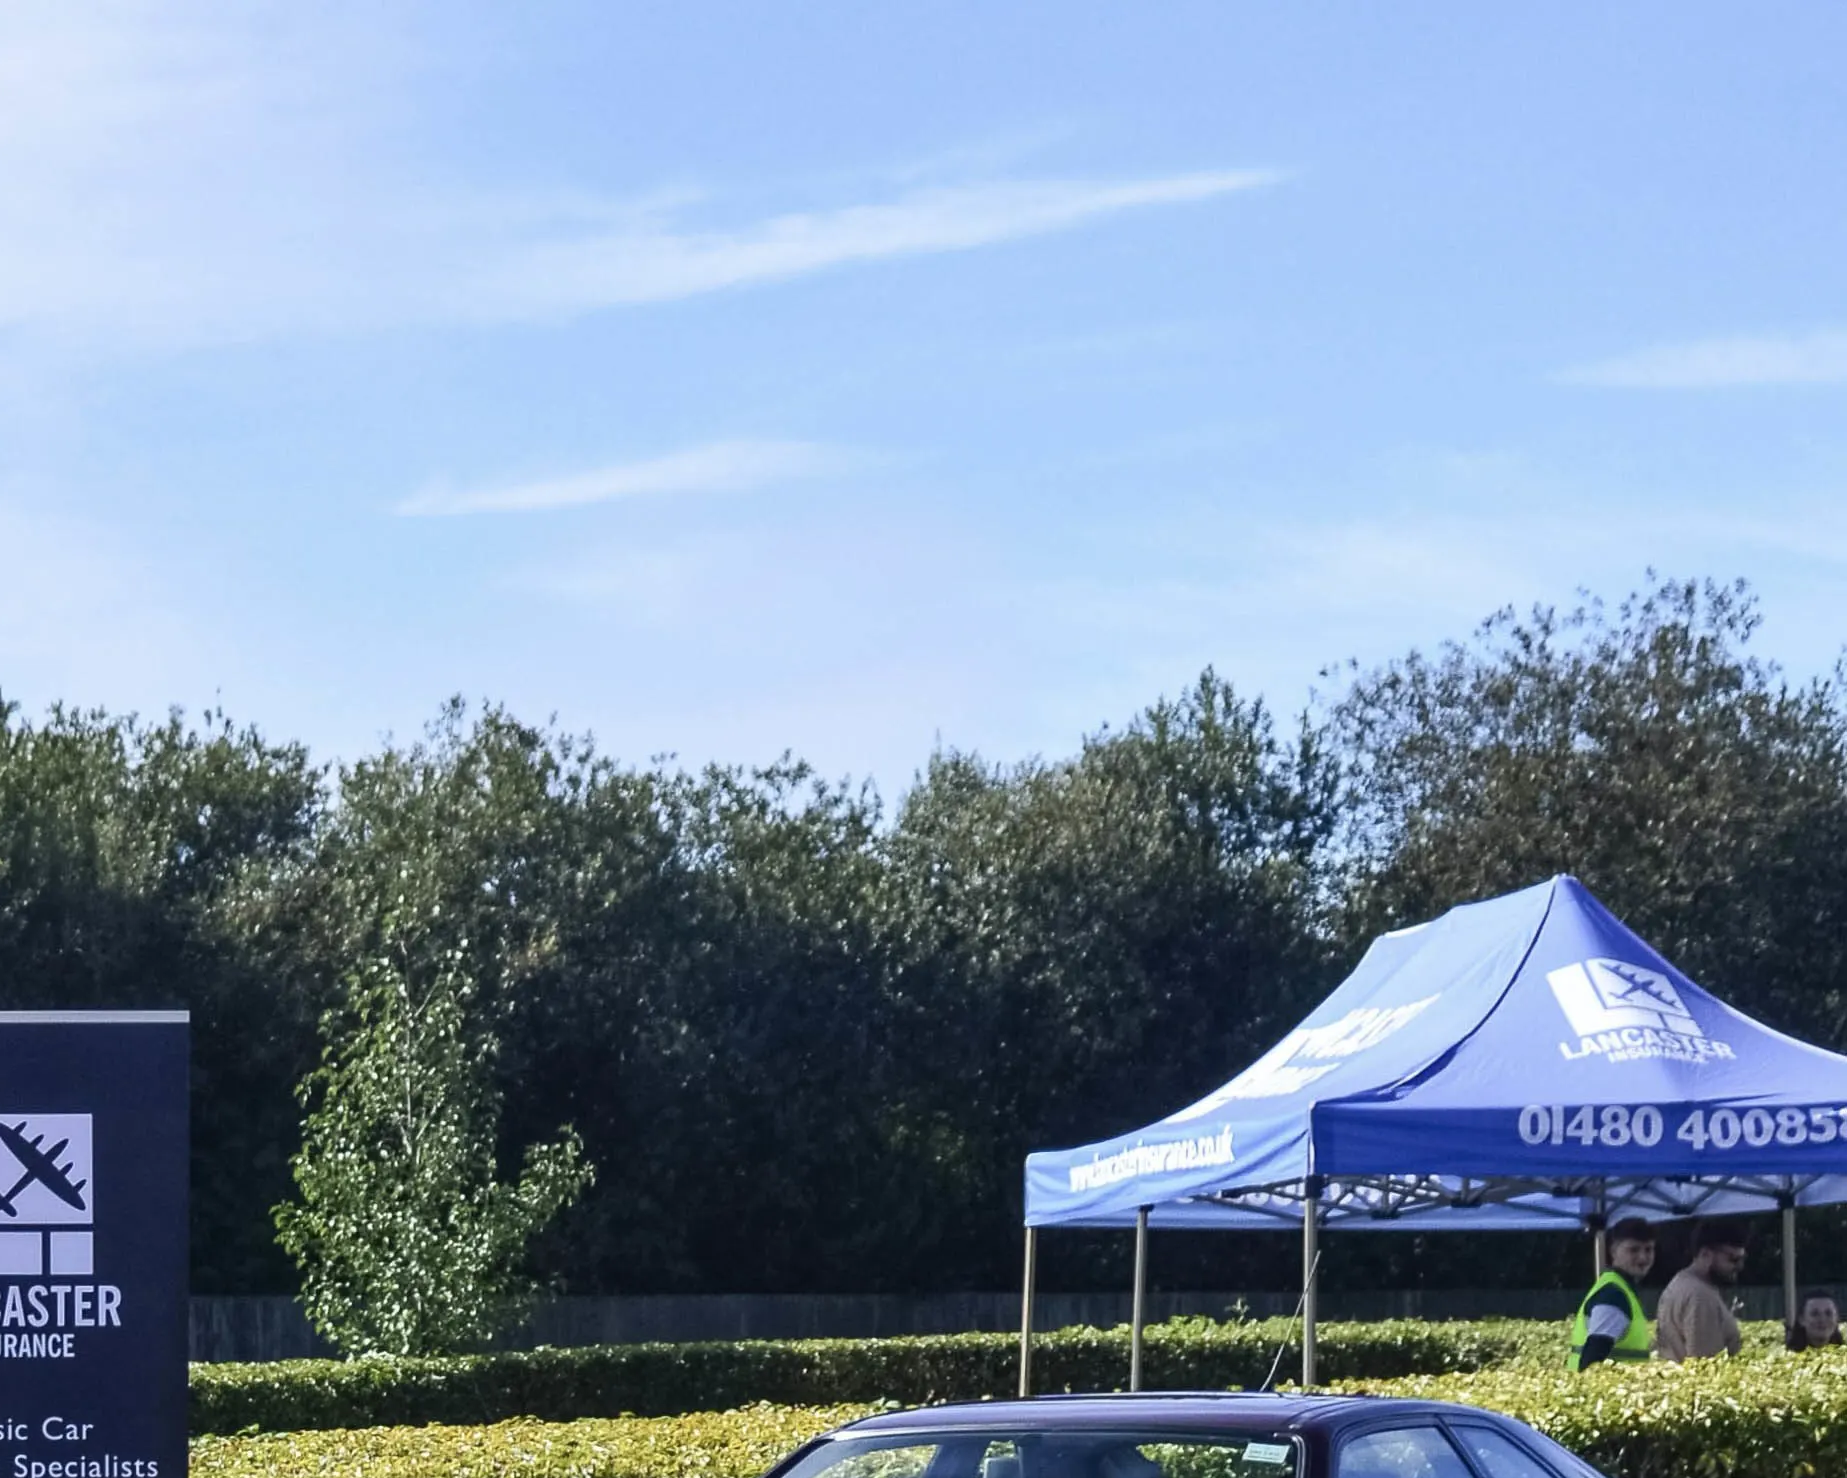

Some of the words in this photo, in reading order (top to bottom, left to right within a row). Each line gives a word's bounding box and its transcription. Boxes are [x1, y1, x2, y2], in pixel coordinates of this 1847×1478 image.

[1559, 1027, 1738, 1061] LANCASTER
[1518, 1104, 1664, 1147] 01480
[1676, 1106, 1847, 1151] 40085
[42, 1416, 94, 1441] Car
